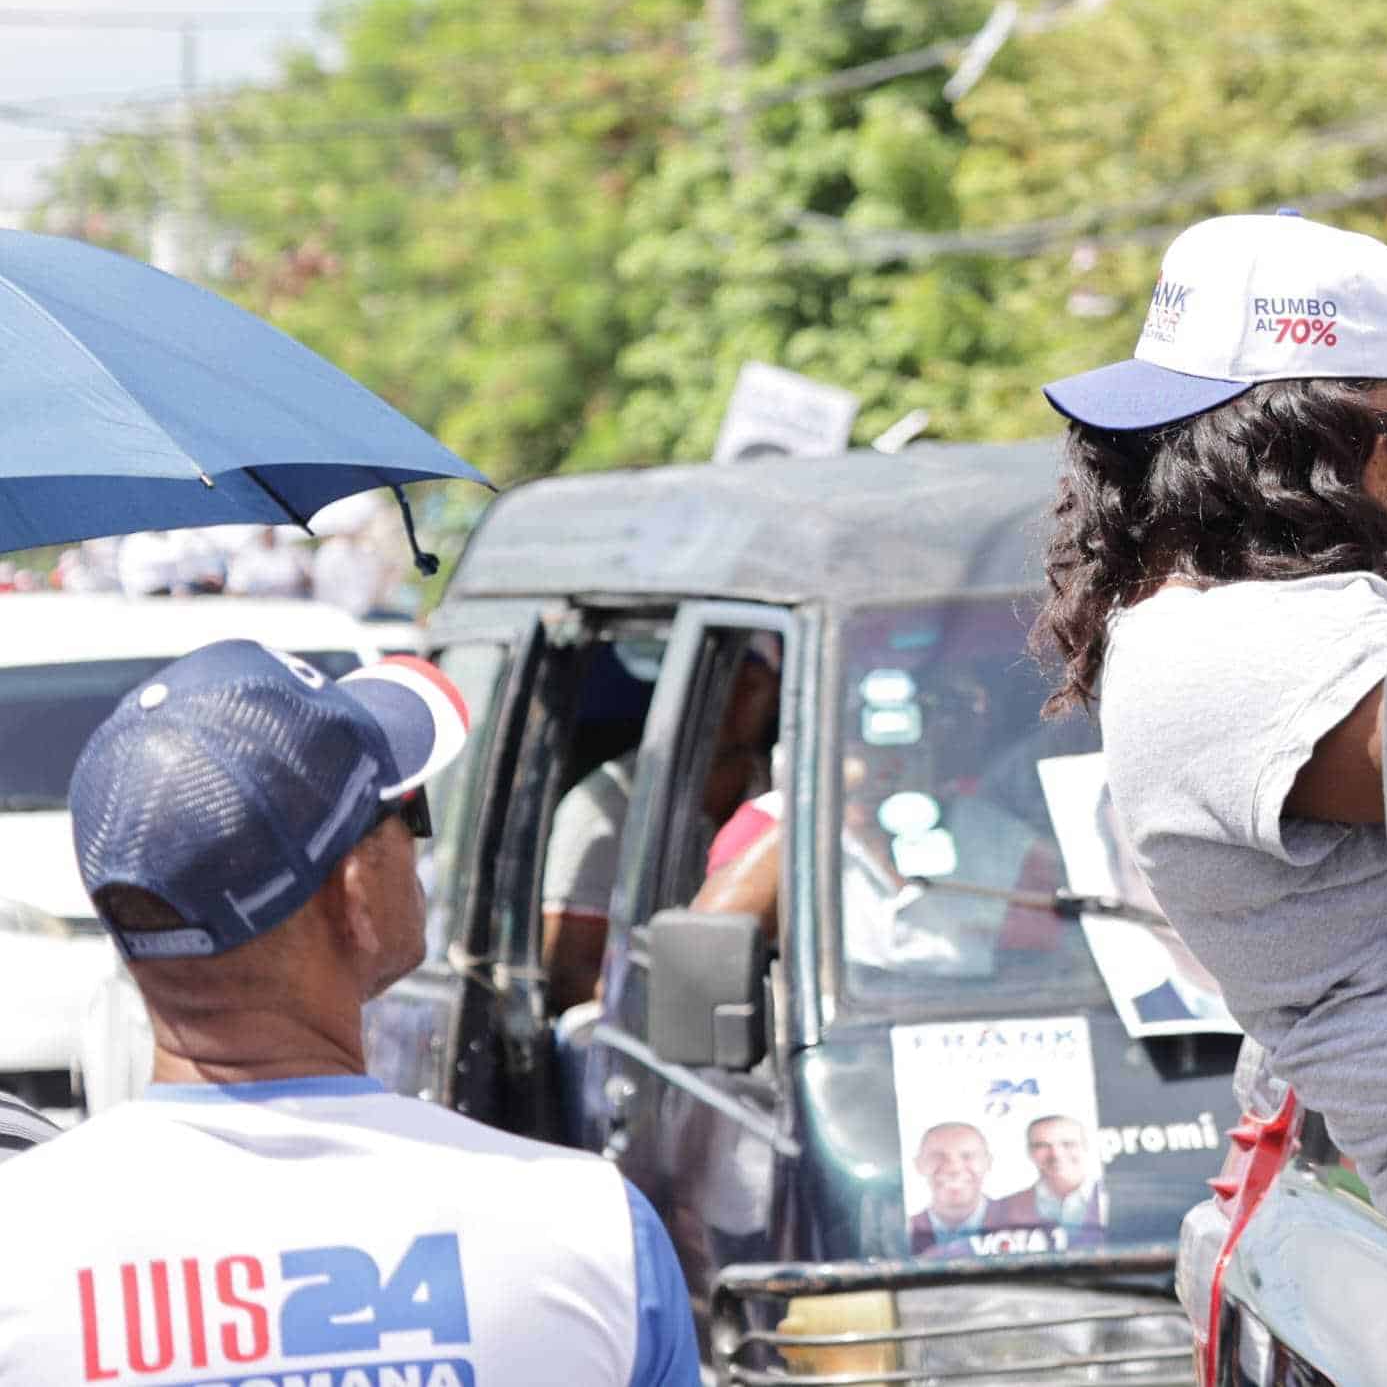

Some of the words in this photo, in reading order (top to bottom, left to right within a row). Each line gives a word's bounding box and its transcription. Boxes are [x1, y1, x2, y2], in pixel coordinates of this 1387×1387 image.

[1255, 298, 1337, 318] RUMBO
[1255, 318, 1278, 332] AL
[1274, 318, 1337, 347] 70%
